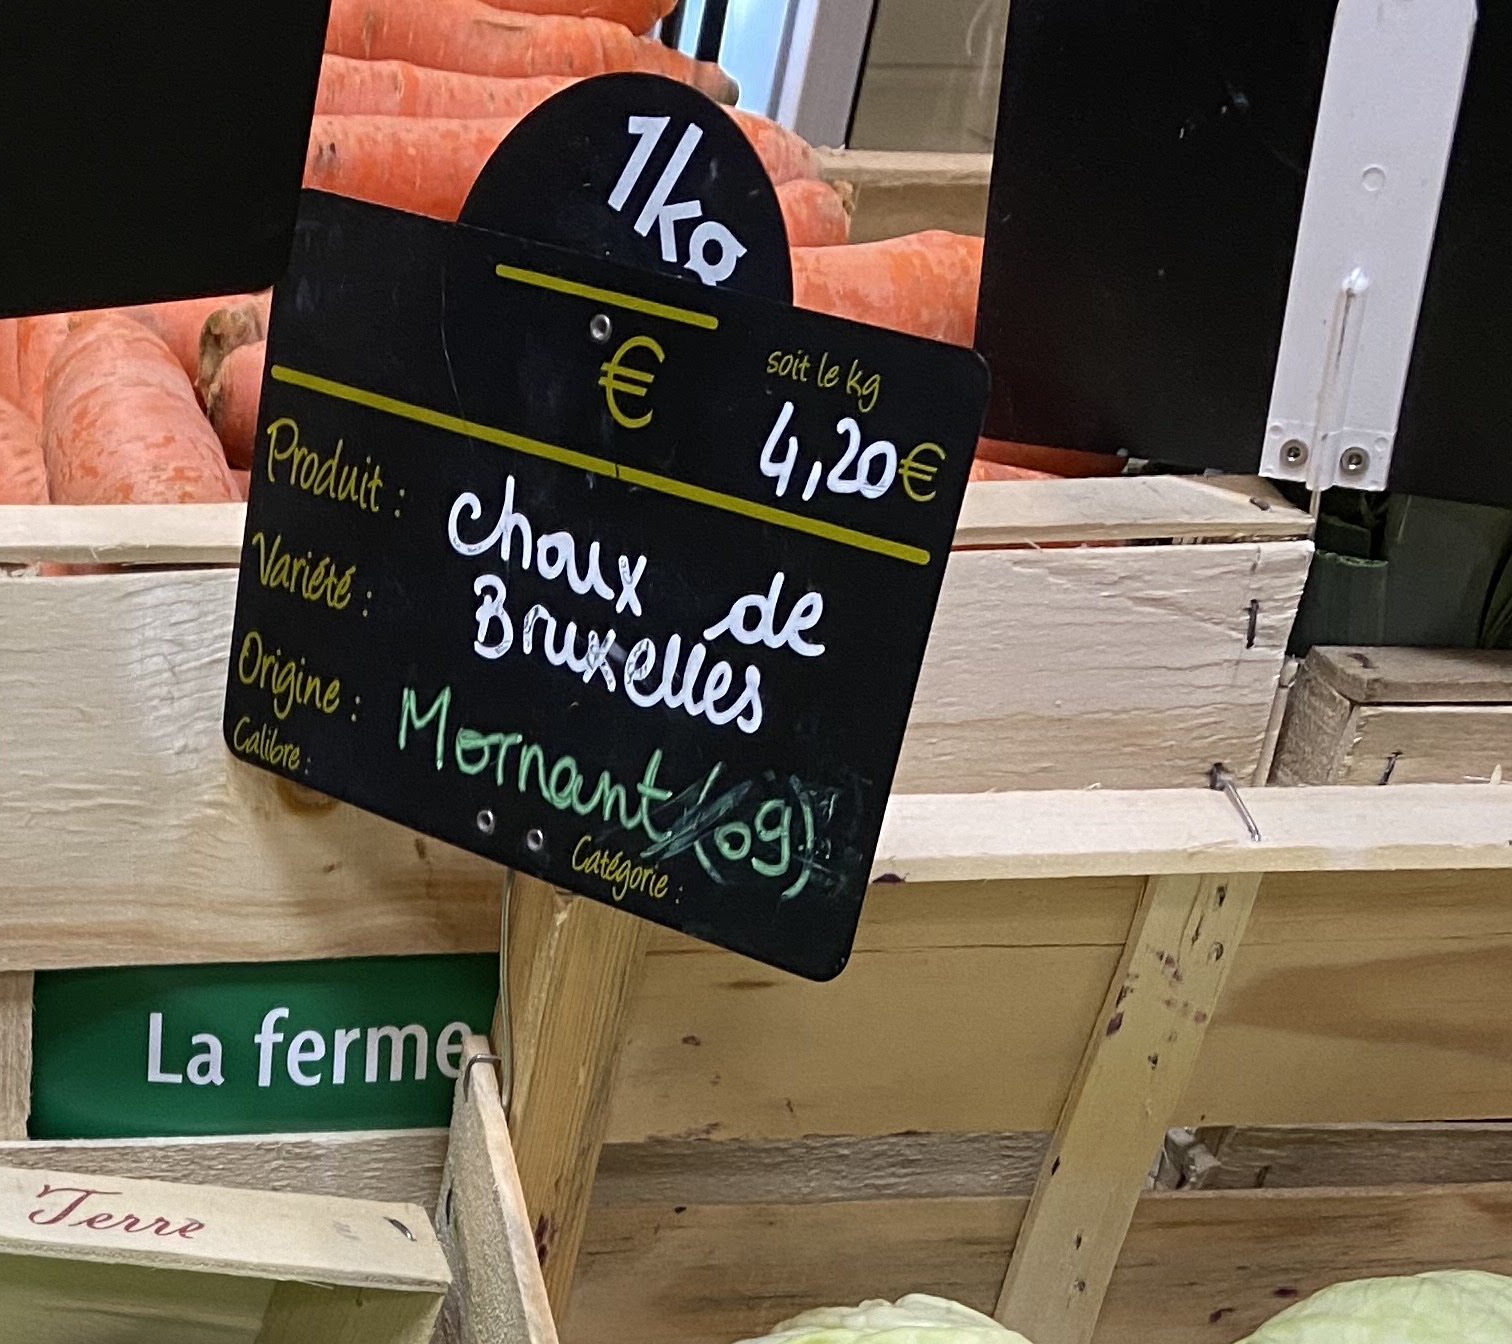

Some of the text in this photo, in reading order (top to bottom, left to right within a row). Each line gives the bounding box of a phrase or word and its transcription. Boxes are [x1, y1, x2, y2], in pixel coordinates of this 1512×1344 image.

[598, 335, 666, 430] €
[767, 350, 882, 413] soit le kg
[267, 417, 383, 513] Produit
[252, 531, 356, 610] Variété
[473, 574, 764, 735] Bruxelles
[703, 571, 827, 658] de
[238, 631, 341, 721] Origine
[398, 686, 673, 844] Mornant
[571, 834, 670, 901] Catégorie
[147, 1006, 474, 1088] La ferme
[26, 1183, 206, 1240] Terre
